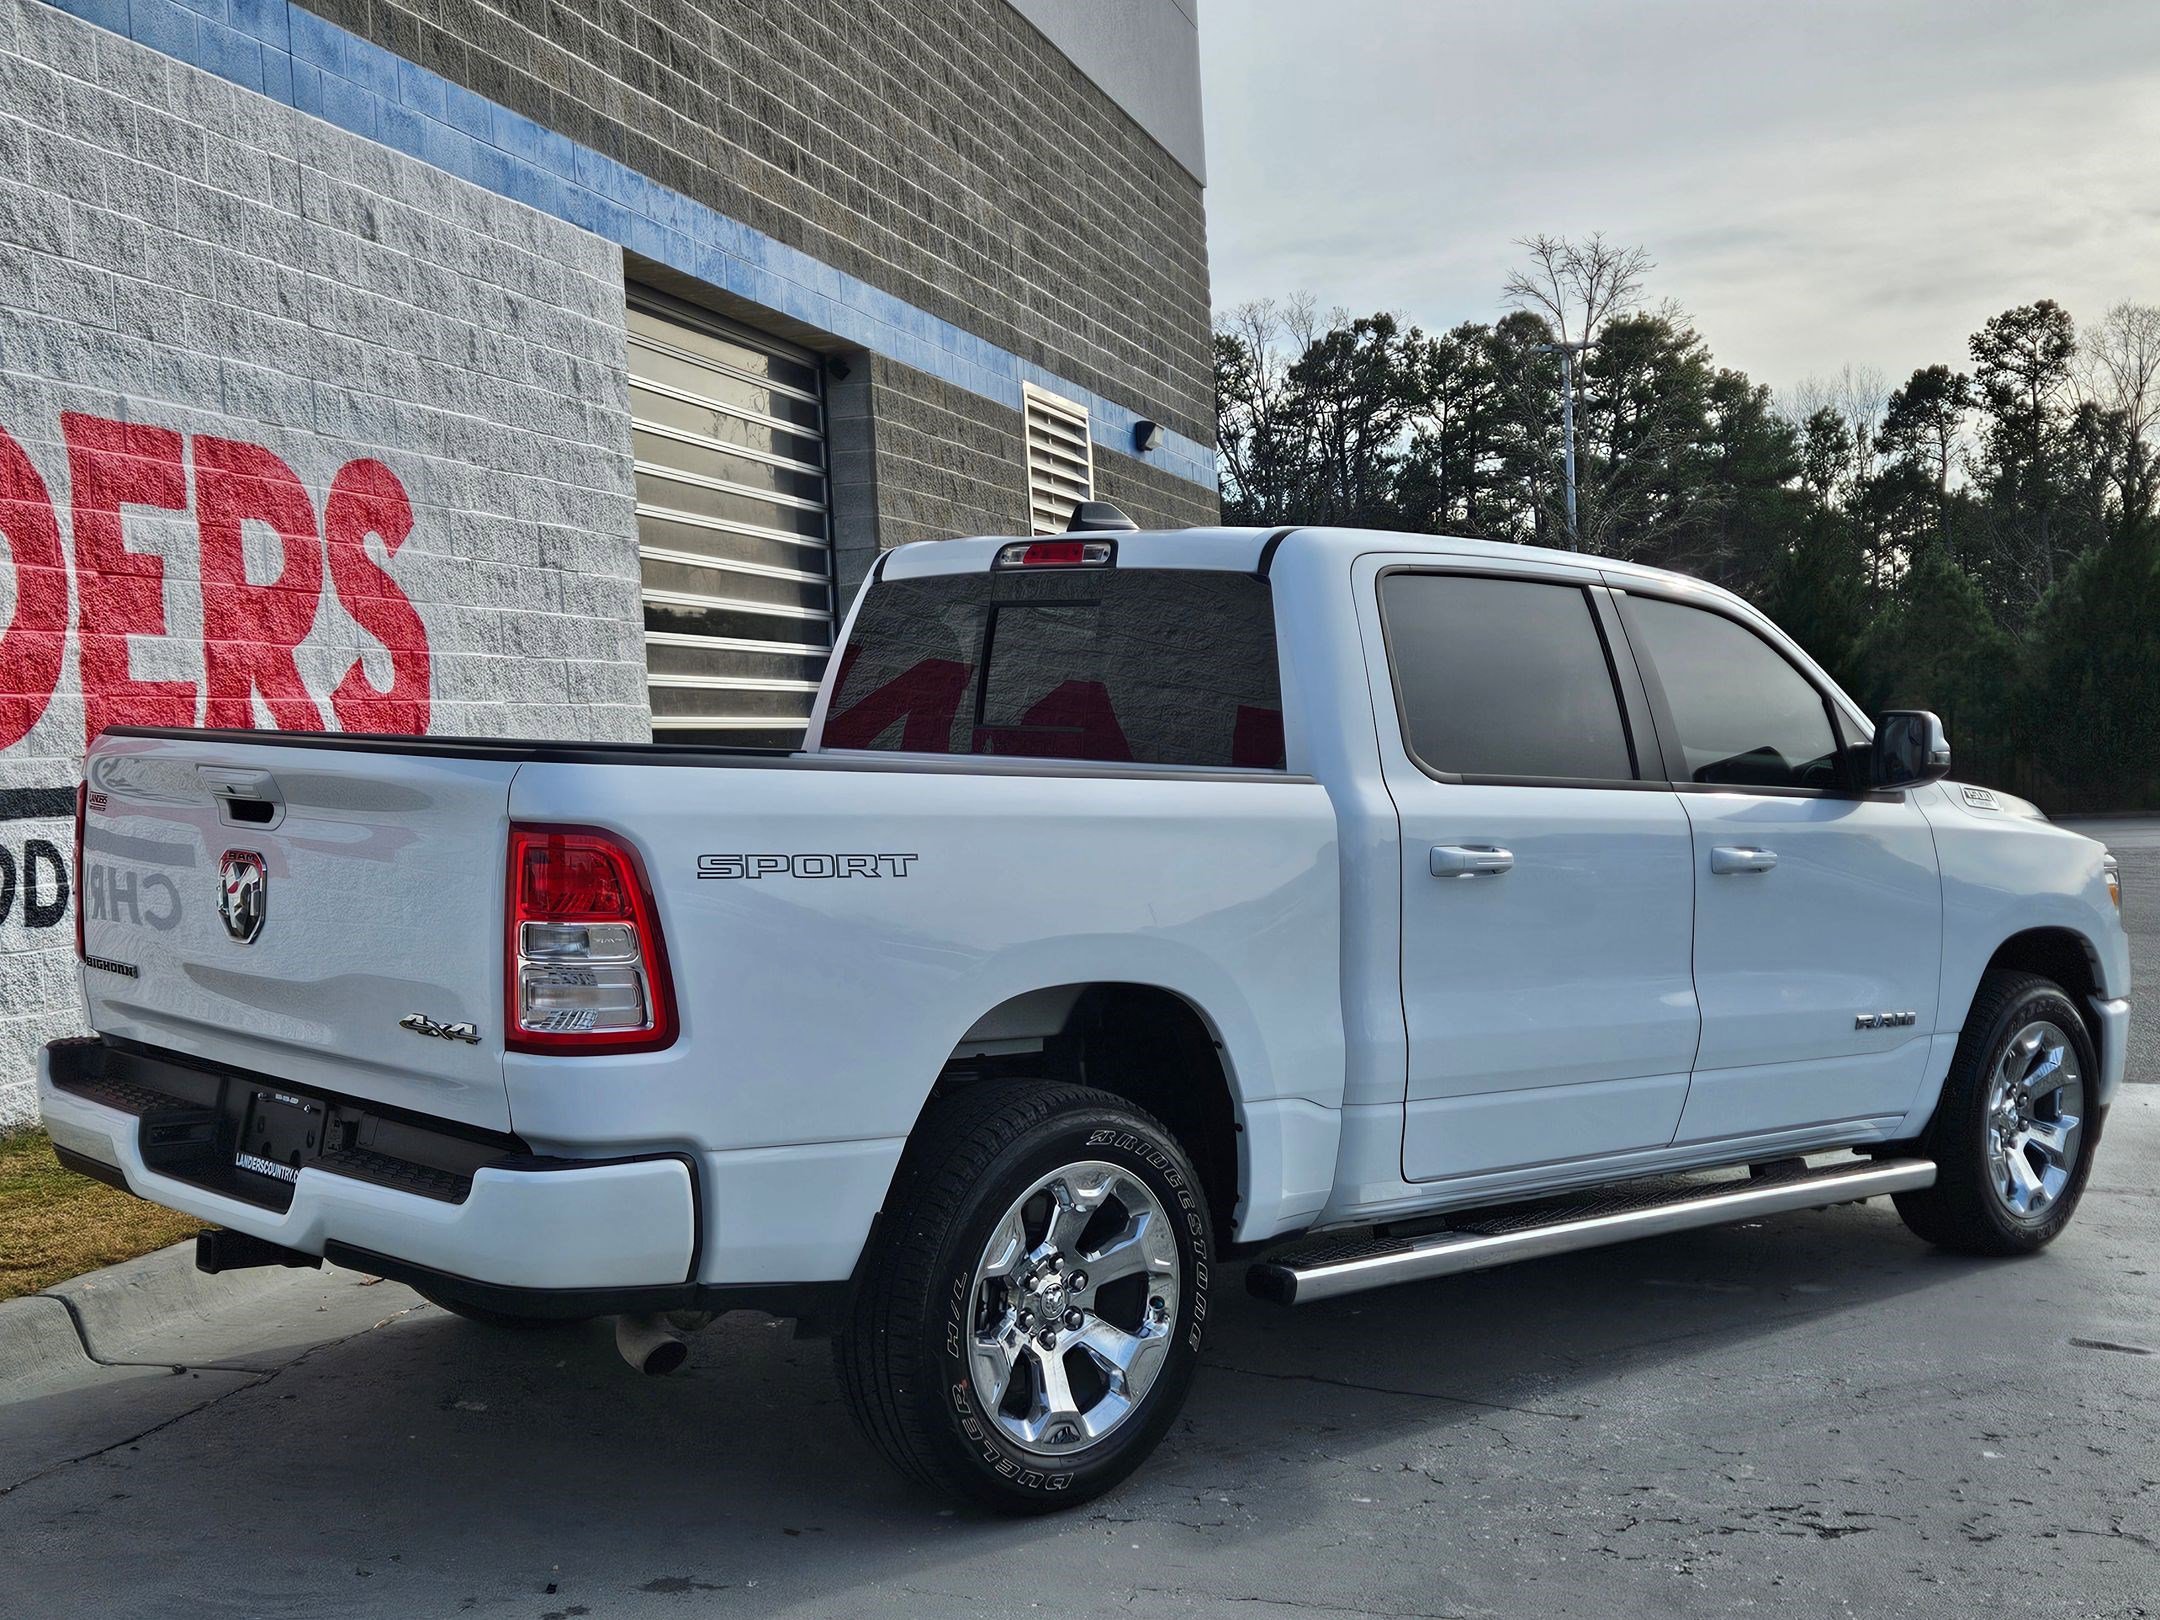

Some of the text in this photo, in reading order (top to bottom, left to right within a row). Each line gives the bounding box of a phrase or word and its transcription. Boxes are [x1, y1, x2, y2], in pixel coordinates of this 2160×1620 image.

[227, 852, 256, 861] RAM
[696, 853, 918, 880] SPORT
[1855, 1011, 1916, 1031] RAM
[1085, 1129, 1211, 1353] BRIDGESTONE
[952, 1382, 1075, 1491] DUELER
